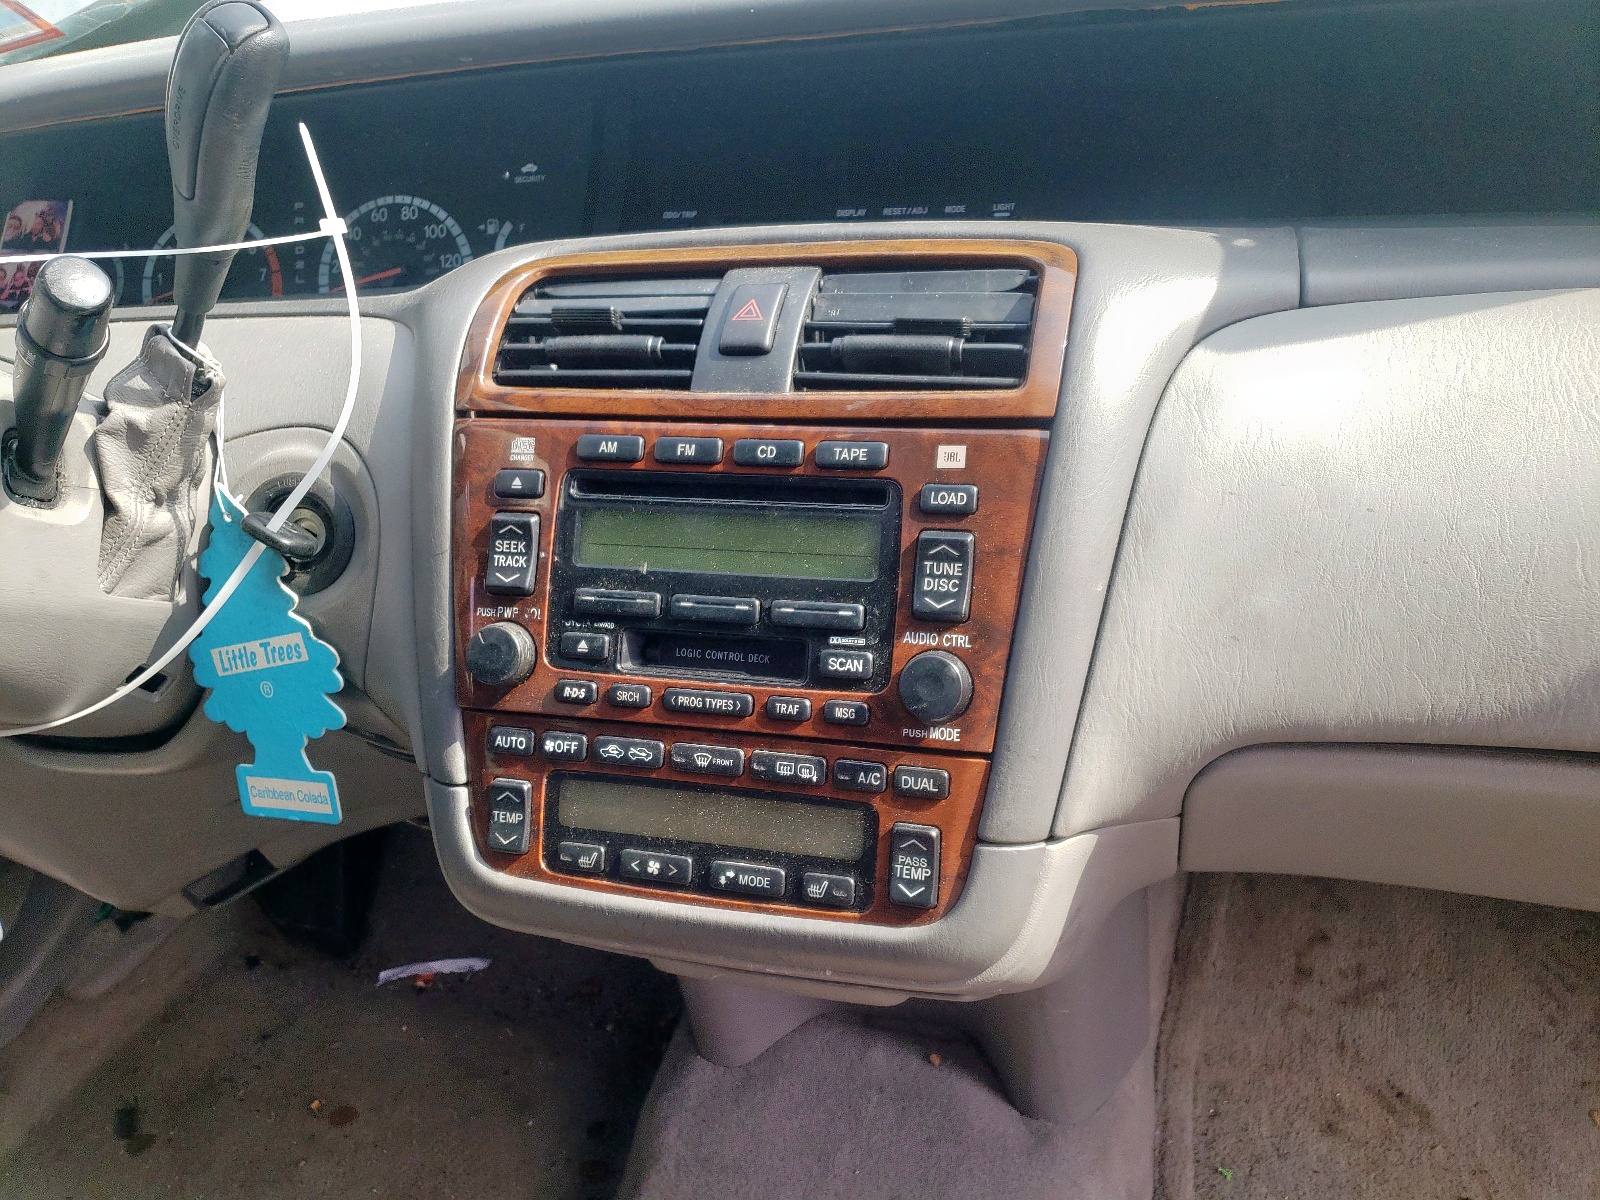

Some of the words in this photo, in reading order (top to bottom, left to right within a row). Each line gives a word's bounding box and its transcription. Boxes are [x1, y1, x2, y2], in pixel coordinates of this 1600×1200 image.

[172, 84, 186, 150] OVERDRIVE
[401, 205, 419, 221] 80
[836, 209, 867, 217] DISPLAY
[883, 207, 929, 216] RESET/ADJ
[945, 205, 966, 213] MODE
[993, 203, 1016, 211] LIGHT
[370, 207, 388, 223] 60
[424, 224, 447, 239] 100
[439, 253, 463, 269] 120
[259, 267, 267, 282] 7
[599, 441, 618, 453] AM
[677, 443, 696, 456] FM
[757, 446, 777, 458] CD
[833, 448, 868, 461] TAPE
[930, 492, 967, 505] LOAD
[495, 540, 526, 553] SEEK
[493, 554, 528, 568] TRACK
[924, 561, 963, 576] TUNE
[923, 577, 960, 592] DISC
[476, 607, 497, 617] PUSH
[903, 631, 939, 645] AUDIO
[943, 634, 972, 648] CTRL
[218, 645, 258, 673] Little
[258, 640, 303, 664] Trees
[676, 647, 702, 659] LOGIC
[705, 650, 745, 662] CONTROL
[748, 653, 770, 664] DECK
[828, 657, 863, 673] SCAN
[616, 690, 640, 702] SRCH
[678, 695, 703, 707] PROG
[705, 698, 734, 710] TYPES
[775, 702, 800, 715] TRAF
[835, 707, 856, 719] MSG
[902, 728, 928, 739] PUSH
[929, 727, 961, 741] MODE
[494, 736, 526, 749] AUTO
[555, 740, 579, 754] OFF
[712, 758, 734, 767] FRONT
[857, 772, 881, 785] A/C
[901, 776, 939, 792] DUAL
[250, 785, 296, 801] Caribbean
[297, 789, 329, 805] Colada
[492, 810, 524, 824] TEMP
[898, 855, 929, 868] PASS
[894, 864, 932, 881] TEMP
[738, 874, 771, 888] MODE
